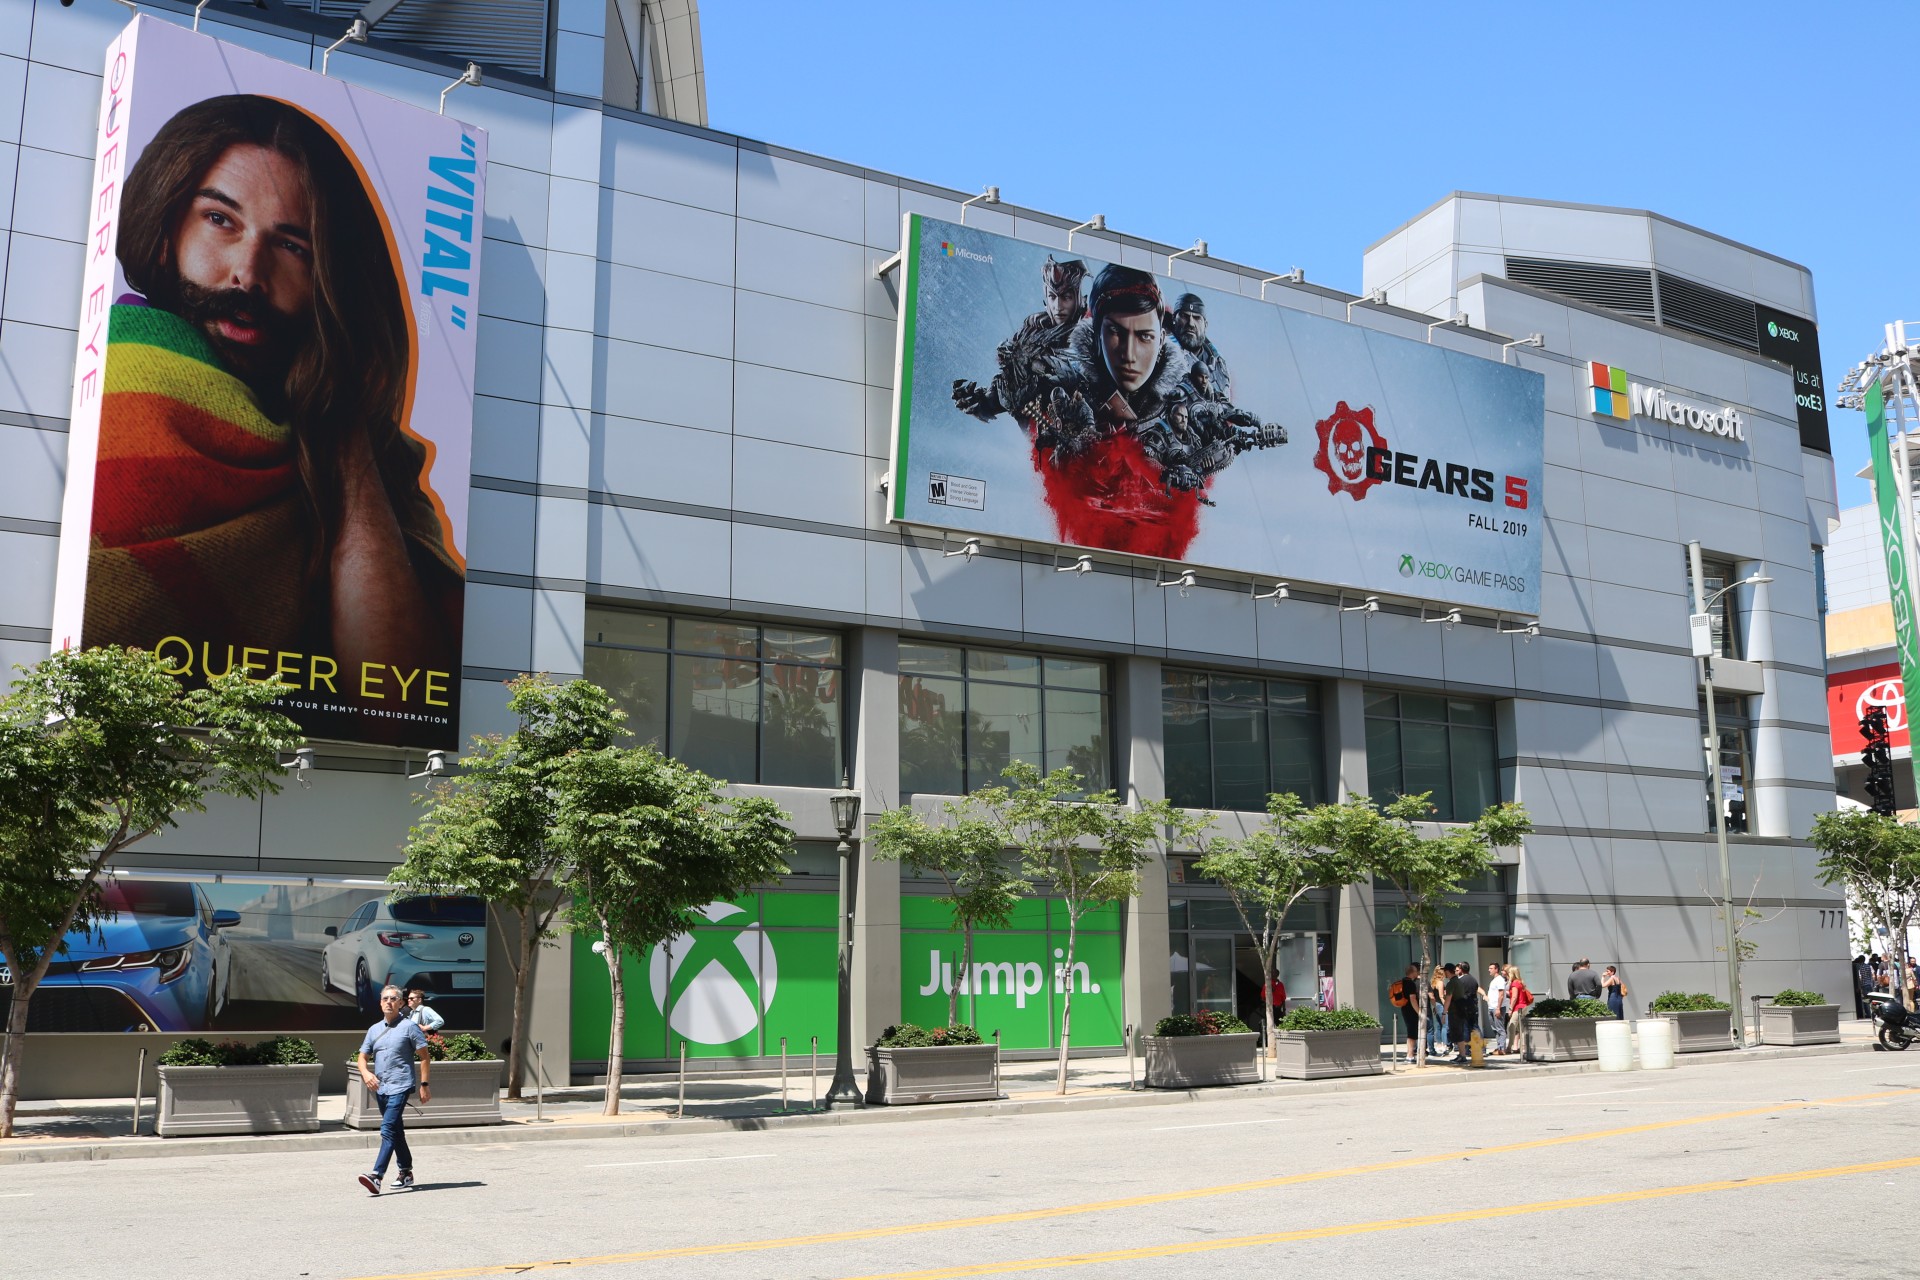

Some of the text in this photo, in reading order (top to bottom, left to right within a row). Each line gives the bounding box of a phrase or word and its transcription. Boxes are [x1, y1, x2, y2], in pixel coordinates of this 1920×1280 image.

[80, 52, 127, 407] QUEER EYE
[955, 248, 994, 265] Microsoft
[1779, 327, 1800, 342] XBOX
[1797, 371, 1820, 388] us at
[1632, 382, 1744, 441] Microsoft
[931, 482, 945, 498] M
[1366, 446, 1528, 510] GEARS 5
[1469, 514, 1528, 537] FALL 2019
[1418, 561, 1525, 592] XBOX GAME PASS
[1883, 504, 1917, 674] XBOX
[155, 636, 450, 707] QUEER EYE
[263, 698, 284, 706] OR
[290, 701, 318, 710] YOUR
[363, 708, 449, 725] CONSIDERATION
[1819, 910, 1844, 929] 777
[920, 948, 1101, 1008] Jump in.
